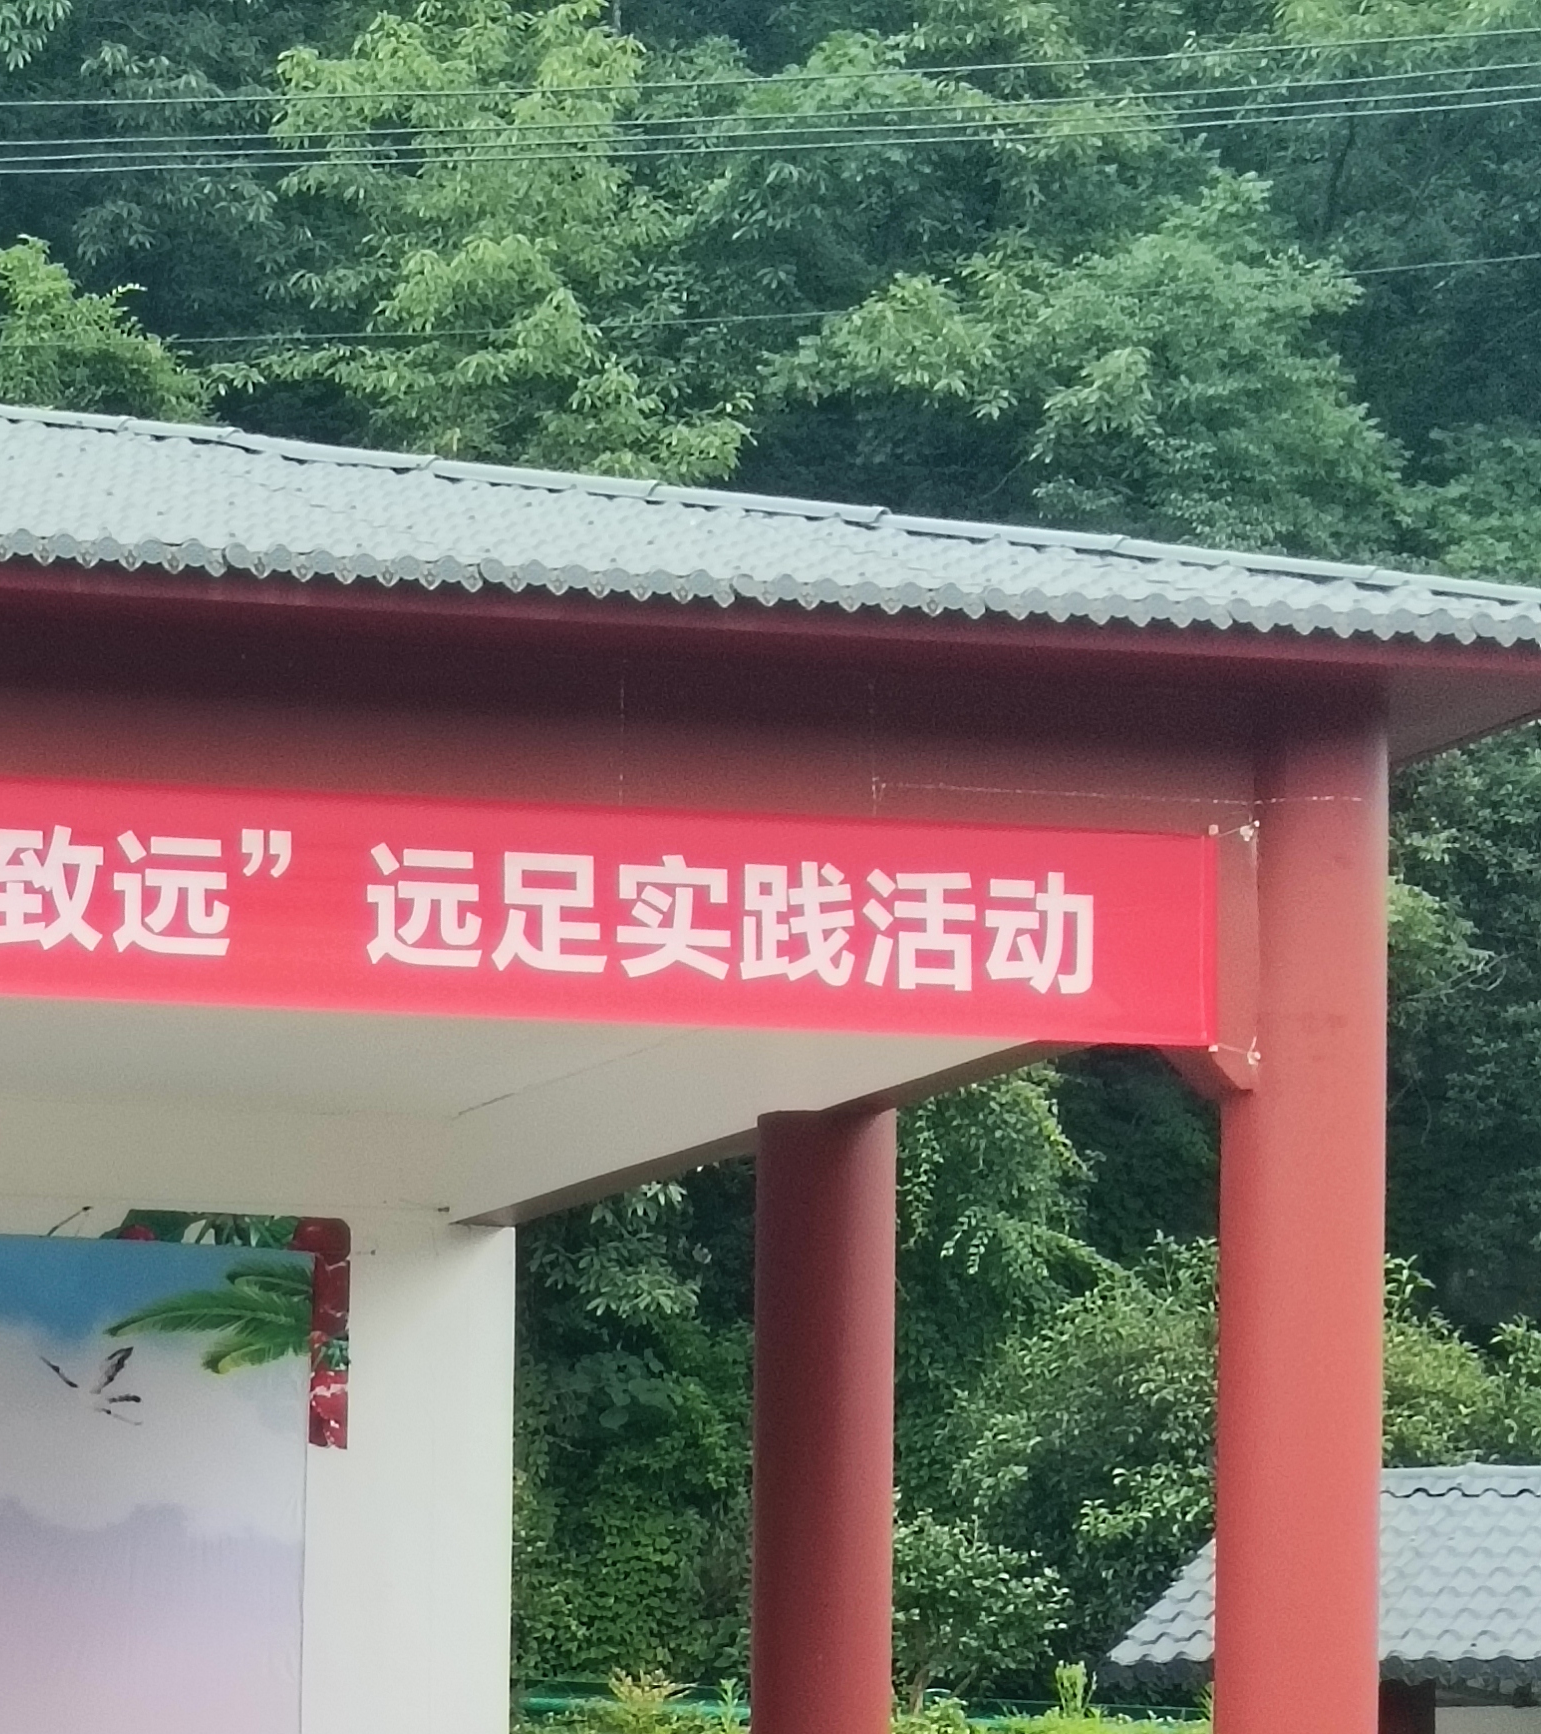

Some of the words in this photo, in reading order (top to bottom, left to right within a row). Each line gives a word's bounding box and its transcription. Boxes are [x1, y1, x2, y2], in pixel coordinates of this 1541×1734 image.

[366, 843, 1096, 995] 远足实践活动
